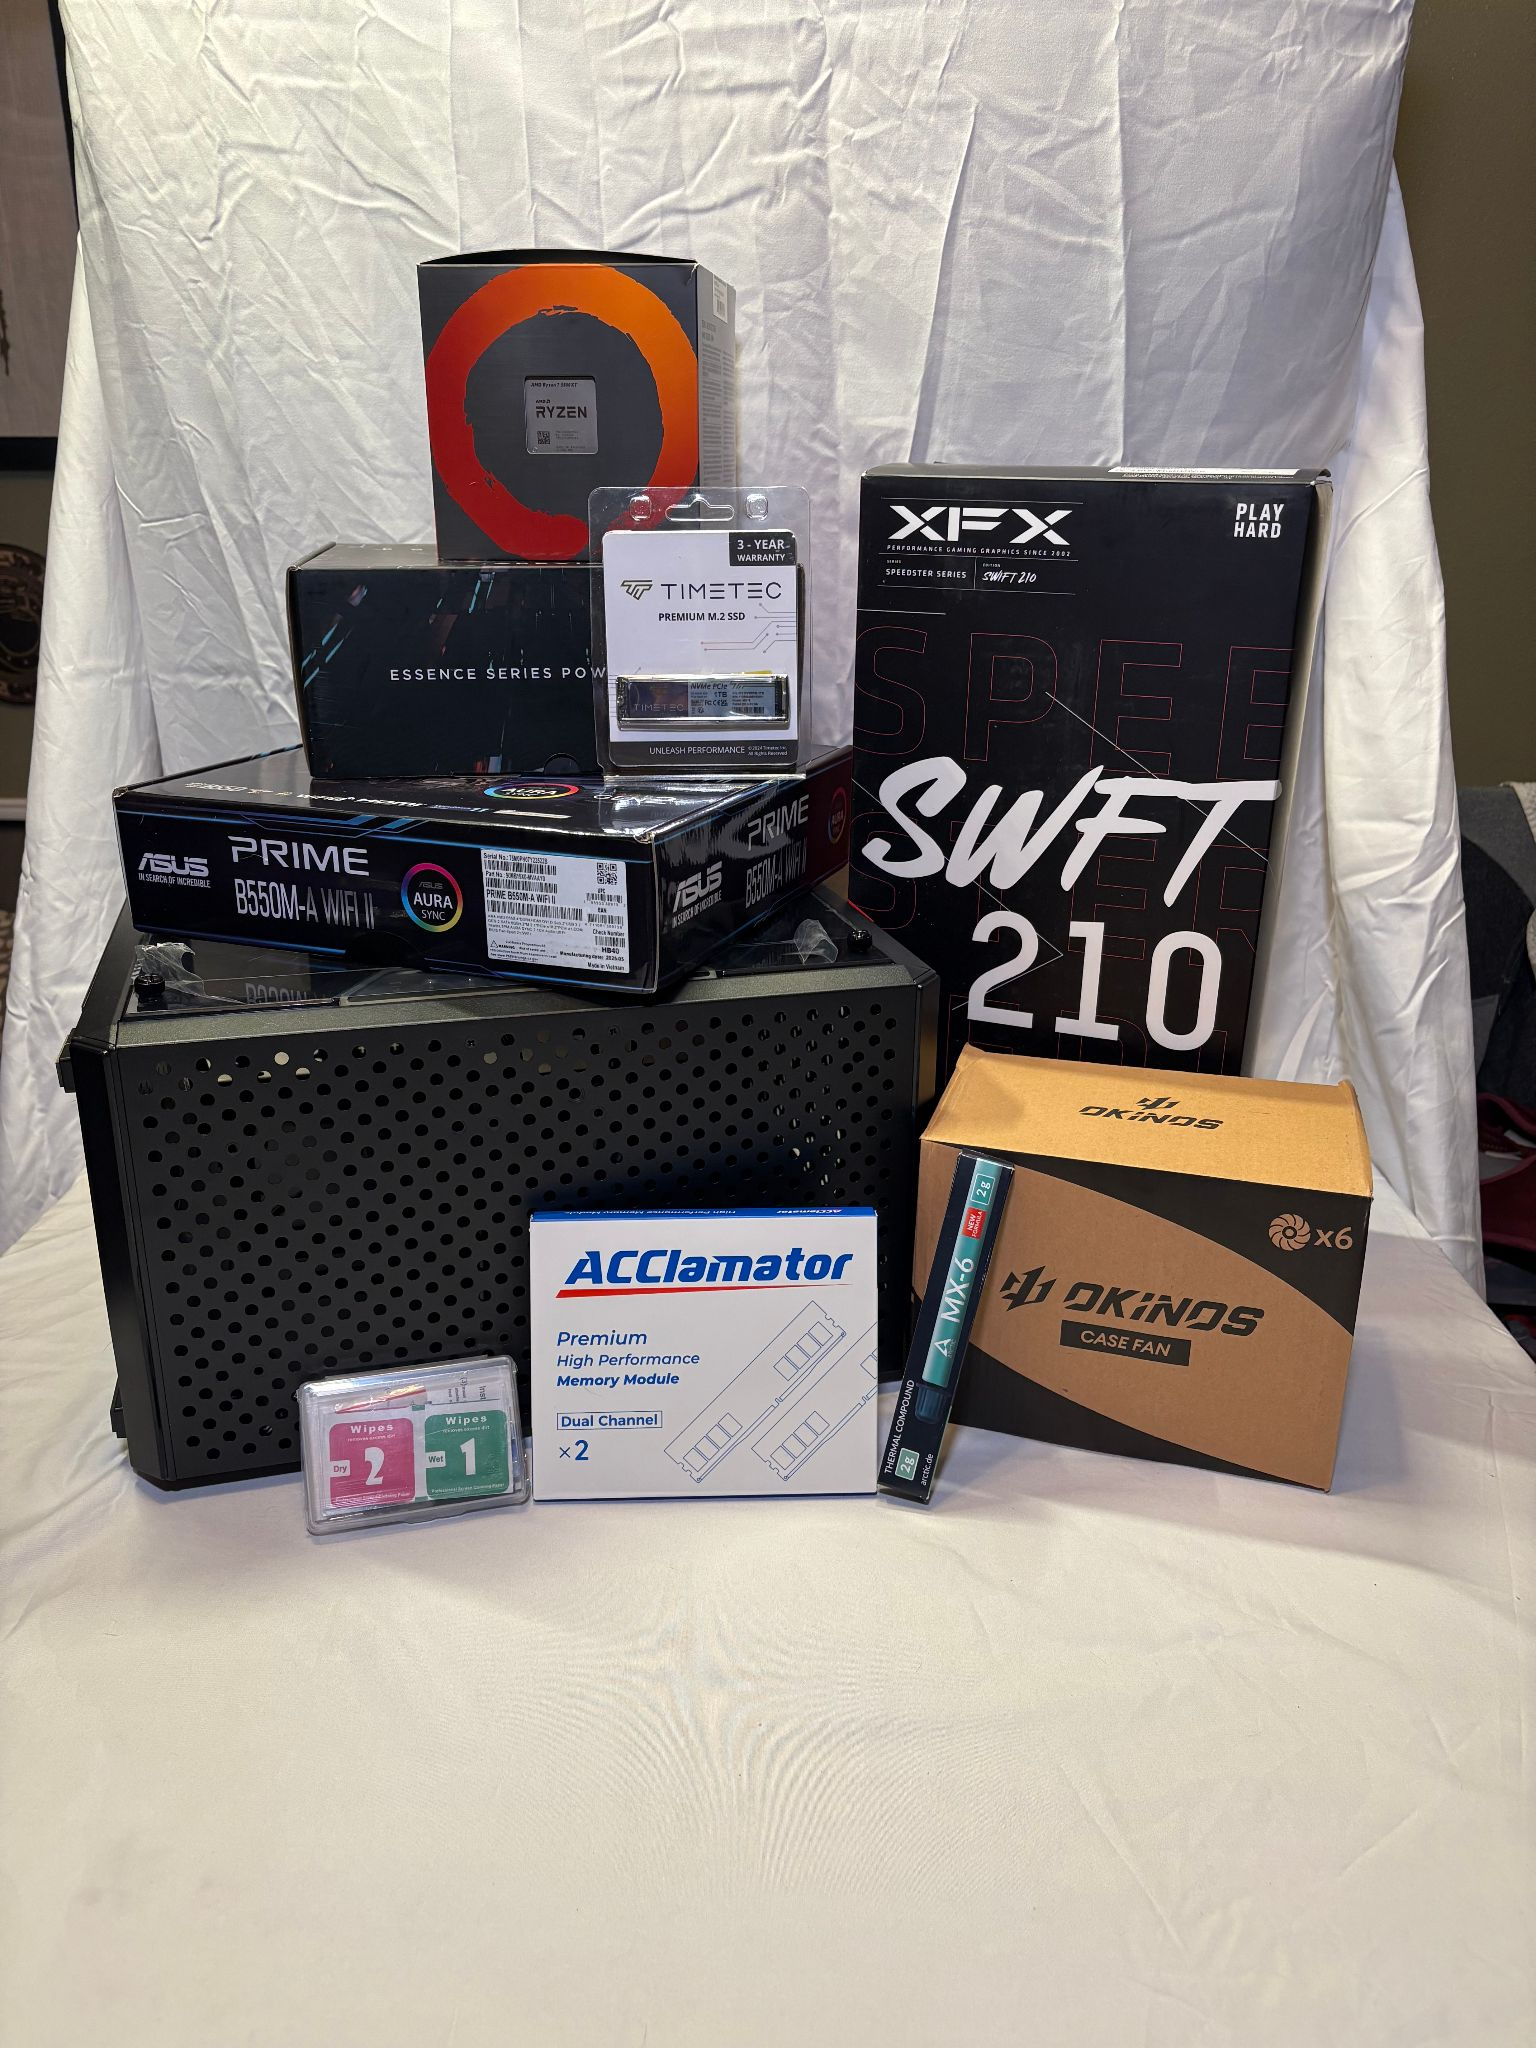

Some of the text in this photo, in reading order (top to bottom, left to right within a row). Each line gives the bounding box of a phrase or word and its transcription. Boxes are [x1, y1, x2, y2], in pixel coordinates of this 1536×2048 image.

[536, 406, 587, 419] RYZEN
[1236, 503, 1284, 521] PLAY
[888, 505, 1073, 546] XFX
[1233, 521, 1281, 539] HARD
[737, 540, 745, 550] 3
[754, 540, 785, 550] YEAR
[886, 545, 943, 553] PERFORMANCE
[737, 554, 785, 562] WARRANTY
[885, 568, 967, 579] SPEEDSTER SERIES
[1018, 571, 1037, 584] 210
[661, 582, 782, 600] TIMETEC
[658, 612, 746, 622] PREMIUM M.2 SSD
[390, 667, 606, 681] ESSENCE SERIES POW
[635, 703, 684, 712] TIMETEC
[649, 746, 745, 755] UNLEASH PERFORMANCE
[747, 794, 810, 851] PRIME
[138, 852, 209, 877] ASUS
[228, 836, 370, 877] PRIME
[145, 873, 168, 884] SEARCH
[168, 876, 176, 885] OF
[176, 877, 211, 889] INCREDIBLE
[419, 881, 443, 890] ASUS
[672, 860, 723, 913] ASUS
[234, 878, 319, 923] B550M-A
[321, 887, 360, 928] WIFI
[413, 891, 454, 910] AURA
[486, 889, 506, 900] PRIME
[507, 890, 535, 903] B550M-A
[536, 893, 551, 904] WIFI
[421, 909, 446, 921] SYNC
[677, 905, 694, 926] SEARCH
[601, 946, 620, 955] HB40
[967, 910, 1222, 1051] 210
[967, 1213, 977, 1231] NEW
[971, 1211, 983, 1238] FORMULA
[1313, 1226, 1353, 1251] x6
[564, 1247, 854, 1285] ACClamator
[940, 1257, 975, 1323] MX-6
[557, 1329, 647, 1346] Premium
[1080, 1329, 1171, 1357] CASE FAN
[557, 1353, 701, 1369] High Performance
[557, 1373, 680, 1389] Memory Module
[446, 1415, 487, 1426] Wipes
[561, 1413, 658, 1427] Dual Channel
[884, 1380, 915, 1474] THERMAL COMPOUND
[350, 1424, 394, 1435] Wipes
[428, 1456, 444, 1464] Wet
[460, 1437, 476, 1476] 1
[333, 1465, 348, 1473] Dry
[364, 1446, 385, 1486] 2
[920, 1453, 934, 1486] arctic.de
